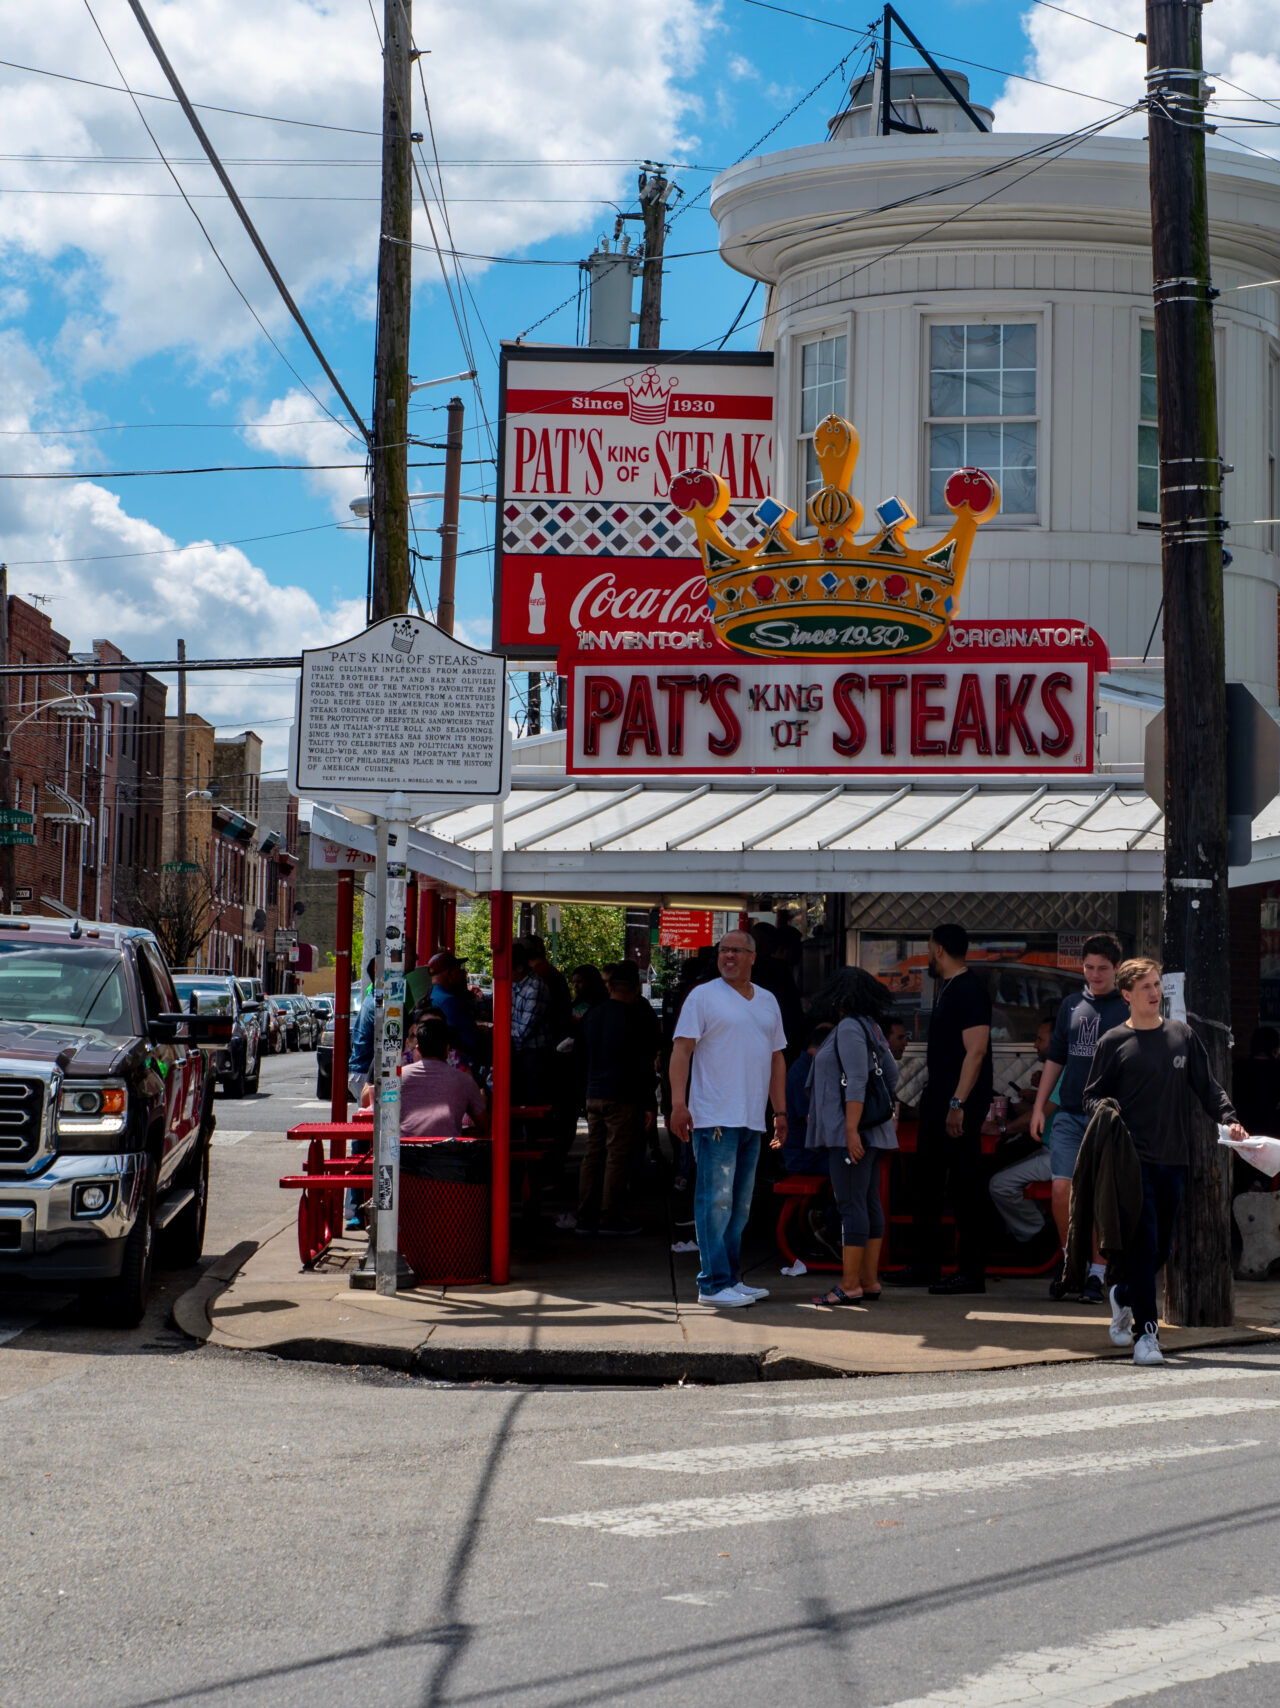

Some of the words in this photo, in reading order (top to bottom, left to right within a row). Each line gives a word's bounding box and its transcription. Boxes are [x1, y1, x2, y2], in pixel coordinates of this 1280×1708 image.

[571, 397, 624, 410] Since
[673, 399, 715, 412] 1930
[512, 427, 603, 496] PAT'S
[608, 446, 649, 463] KING
[654, 430, 772, 500] STEAK
[616, 465, 640, 482] OF
[579, 628, 707, 650] INVENTOR
[754, 621, 838, 648] Since
[838, 624, 904, 648] 1930
[951, 626, 1089, 649] ORIGINATOR
[371, 653, 404, 663] KING
[407, 654, 424, 664] OF
[751, 683, 823, 712] KING
[584, 673, 741, 757] PAT'S
[832, 672, 1075, 757] STEAKS
[774, 719, 809, 748] OF
[1059, 935, 1080, 945] CASH
[1076, 1016, 1100, 1046] M
